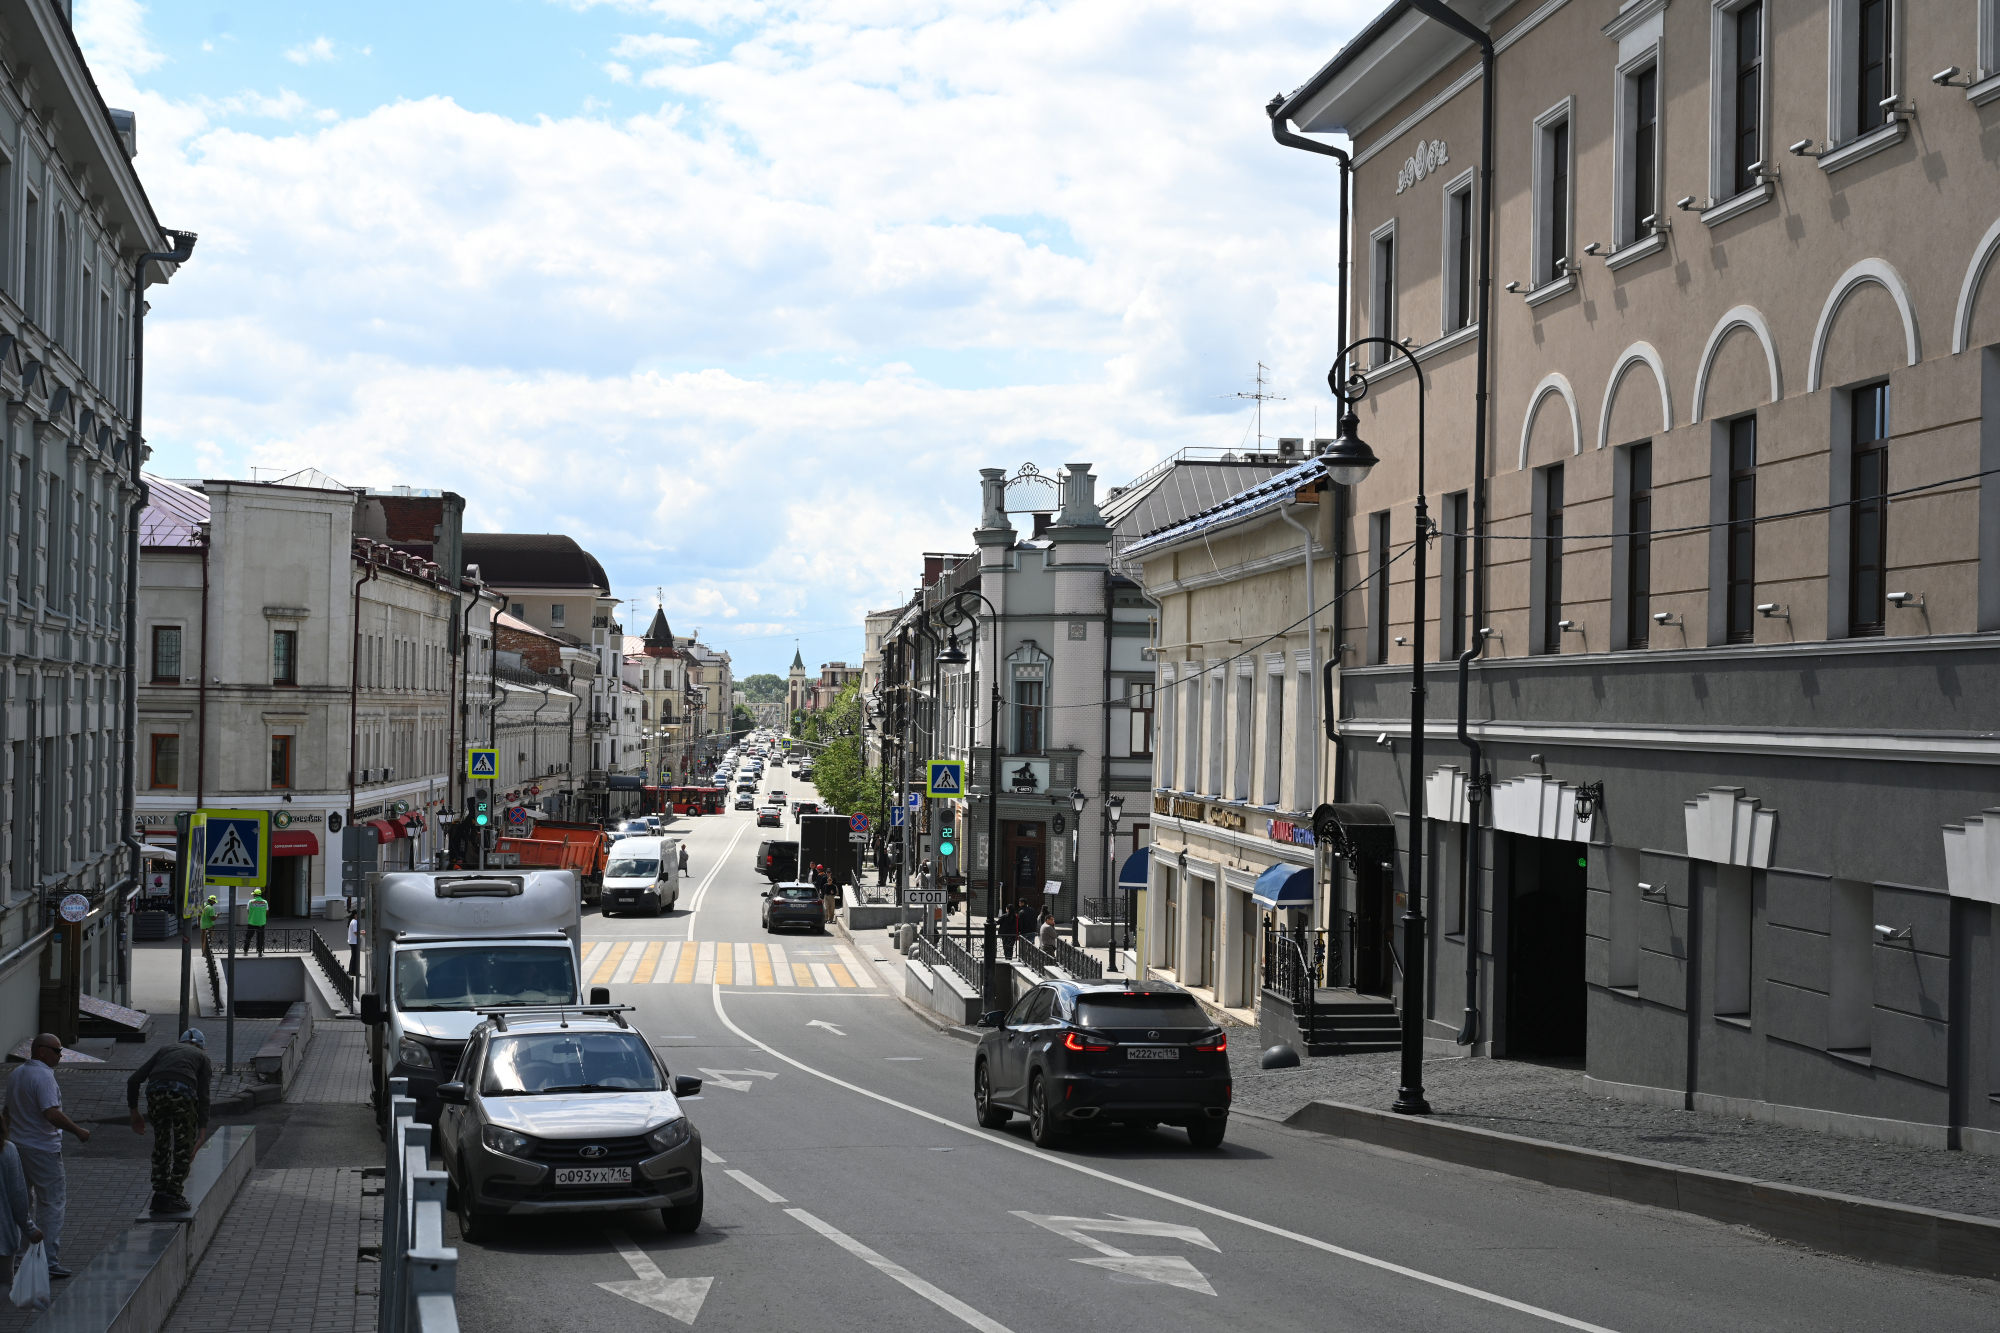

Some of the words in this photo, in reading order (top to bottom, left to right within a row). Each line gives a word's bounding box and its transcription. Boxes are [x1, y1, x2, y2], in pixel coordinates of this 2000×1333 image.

[478, 803, 487, 811] 22
[291, 814, 323, 823] КОФЕЙНЯ
[942, 827, 953, 838] 22
[1271, 820, 1295, 842] АЛМАЗ
[909, 892, 942, 902] СТОП
[1129, 1049, 1163, 1059] М222УС
[559, 1169, 608, 1183] О093УХ
[609, 1168, 628, 1178] 716
